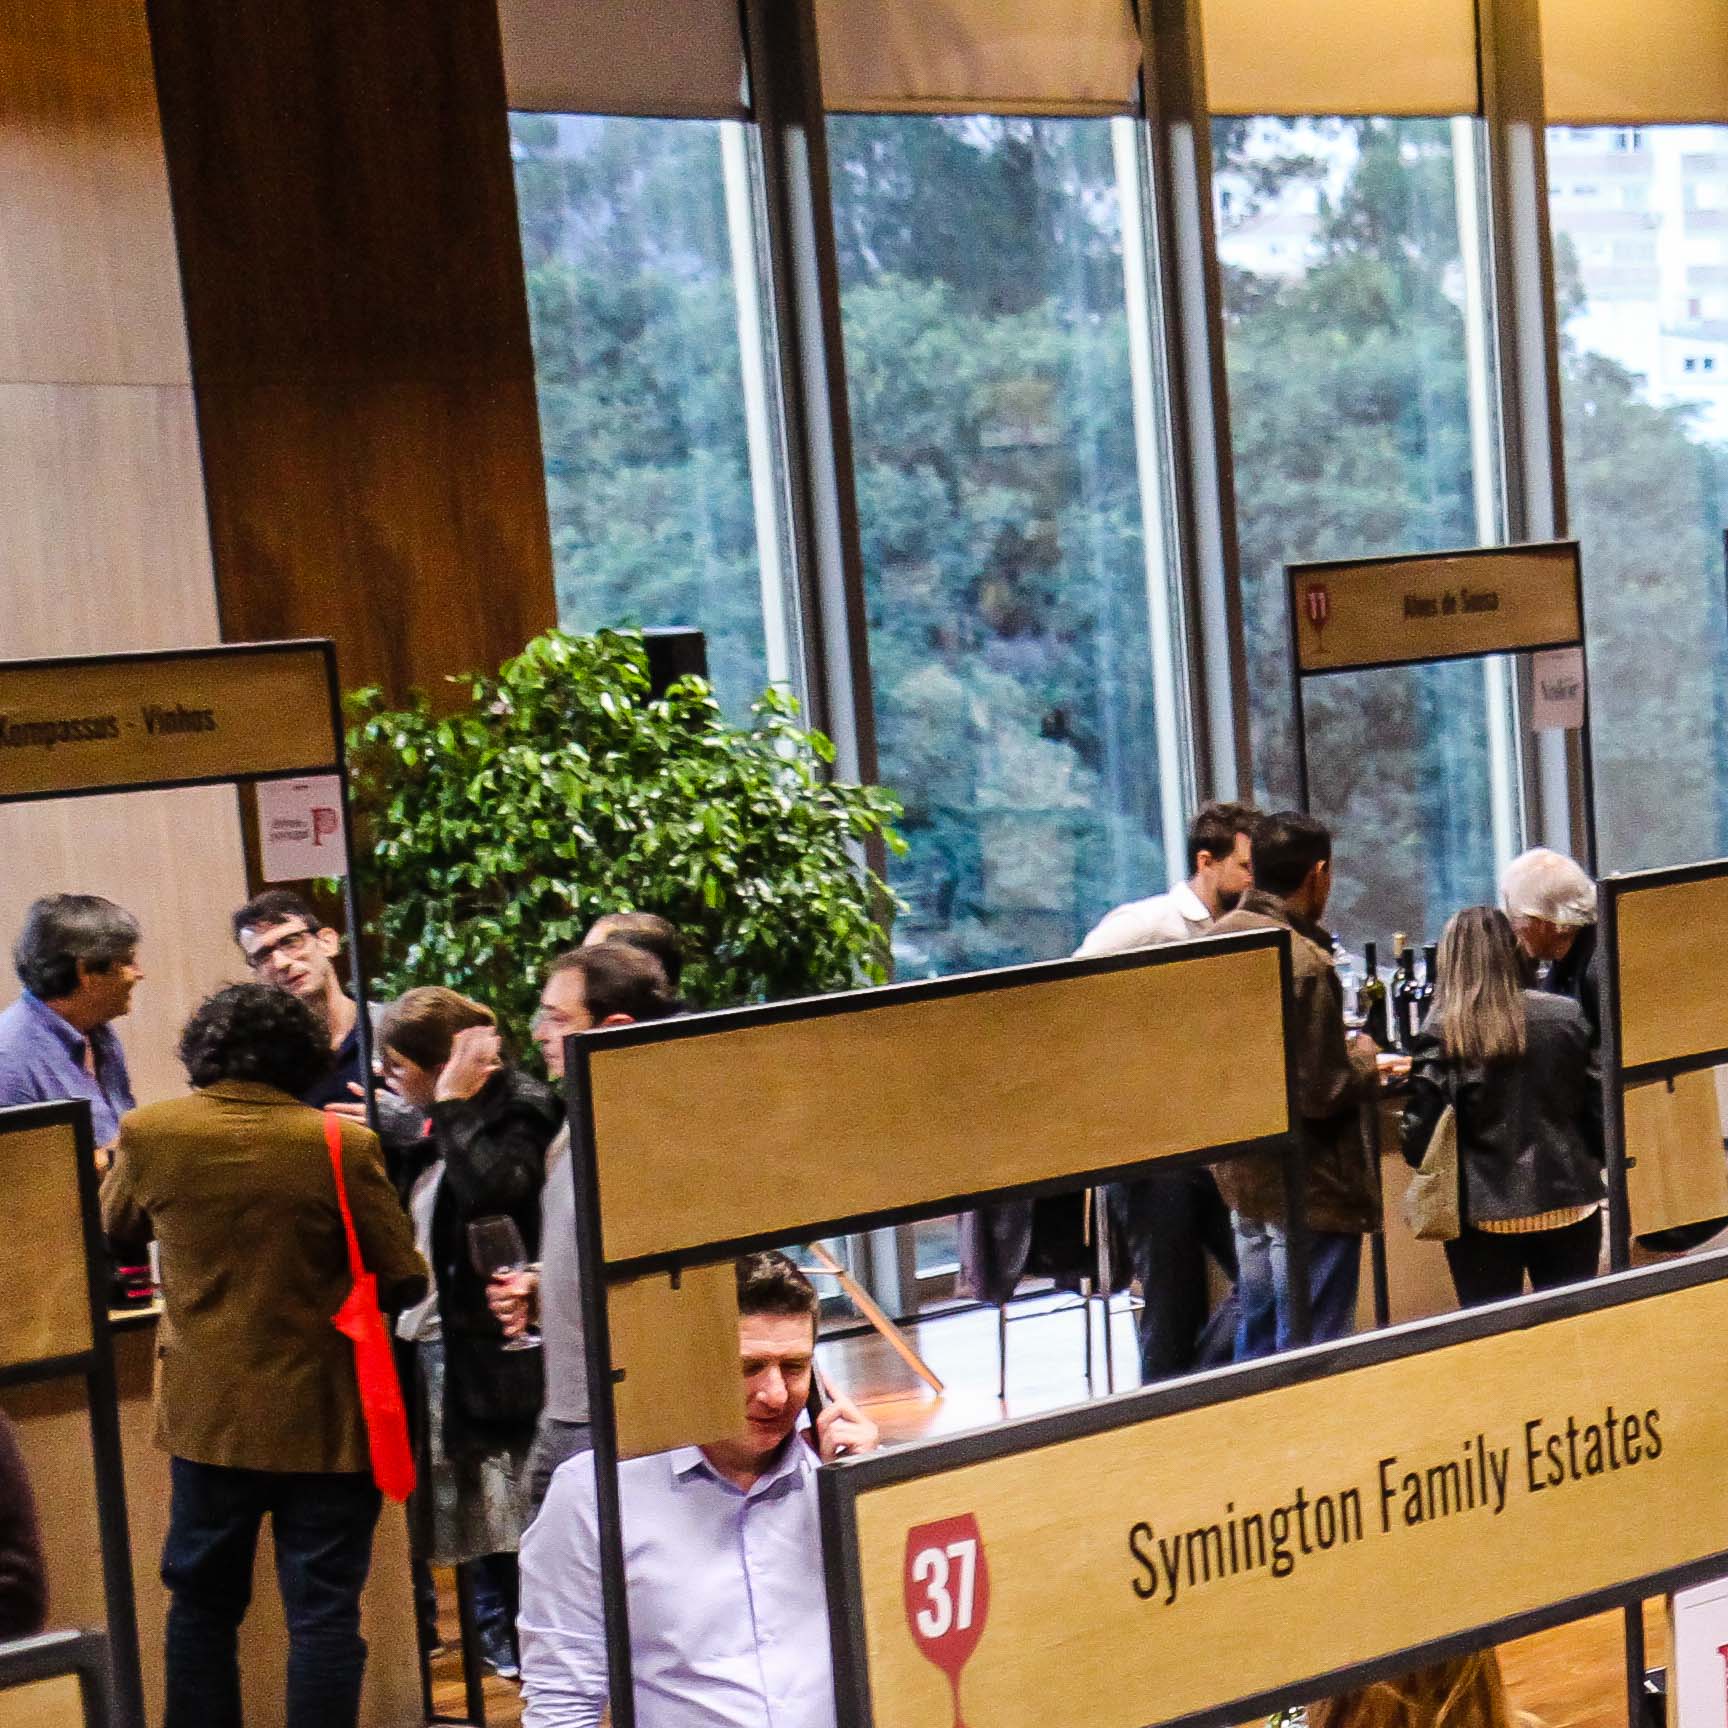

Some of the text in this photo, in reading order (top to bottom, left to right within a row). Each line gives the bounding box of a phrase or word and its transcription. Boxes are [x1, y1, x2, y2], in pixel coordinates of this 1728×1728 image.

[1128, 1405, 1664, 1607] Symington Family Estates
[910, 1538, 978, 1638] 37
